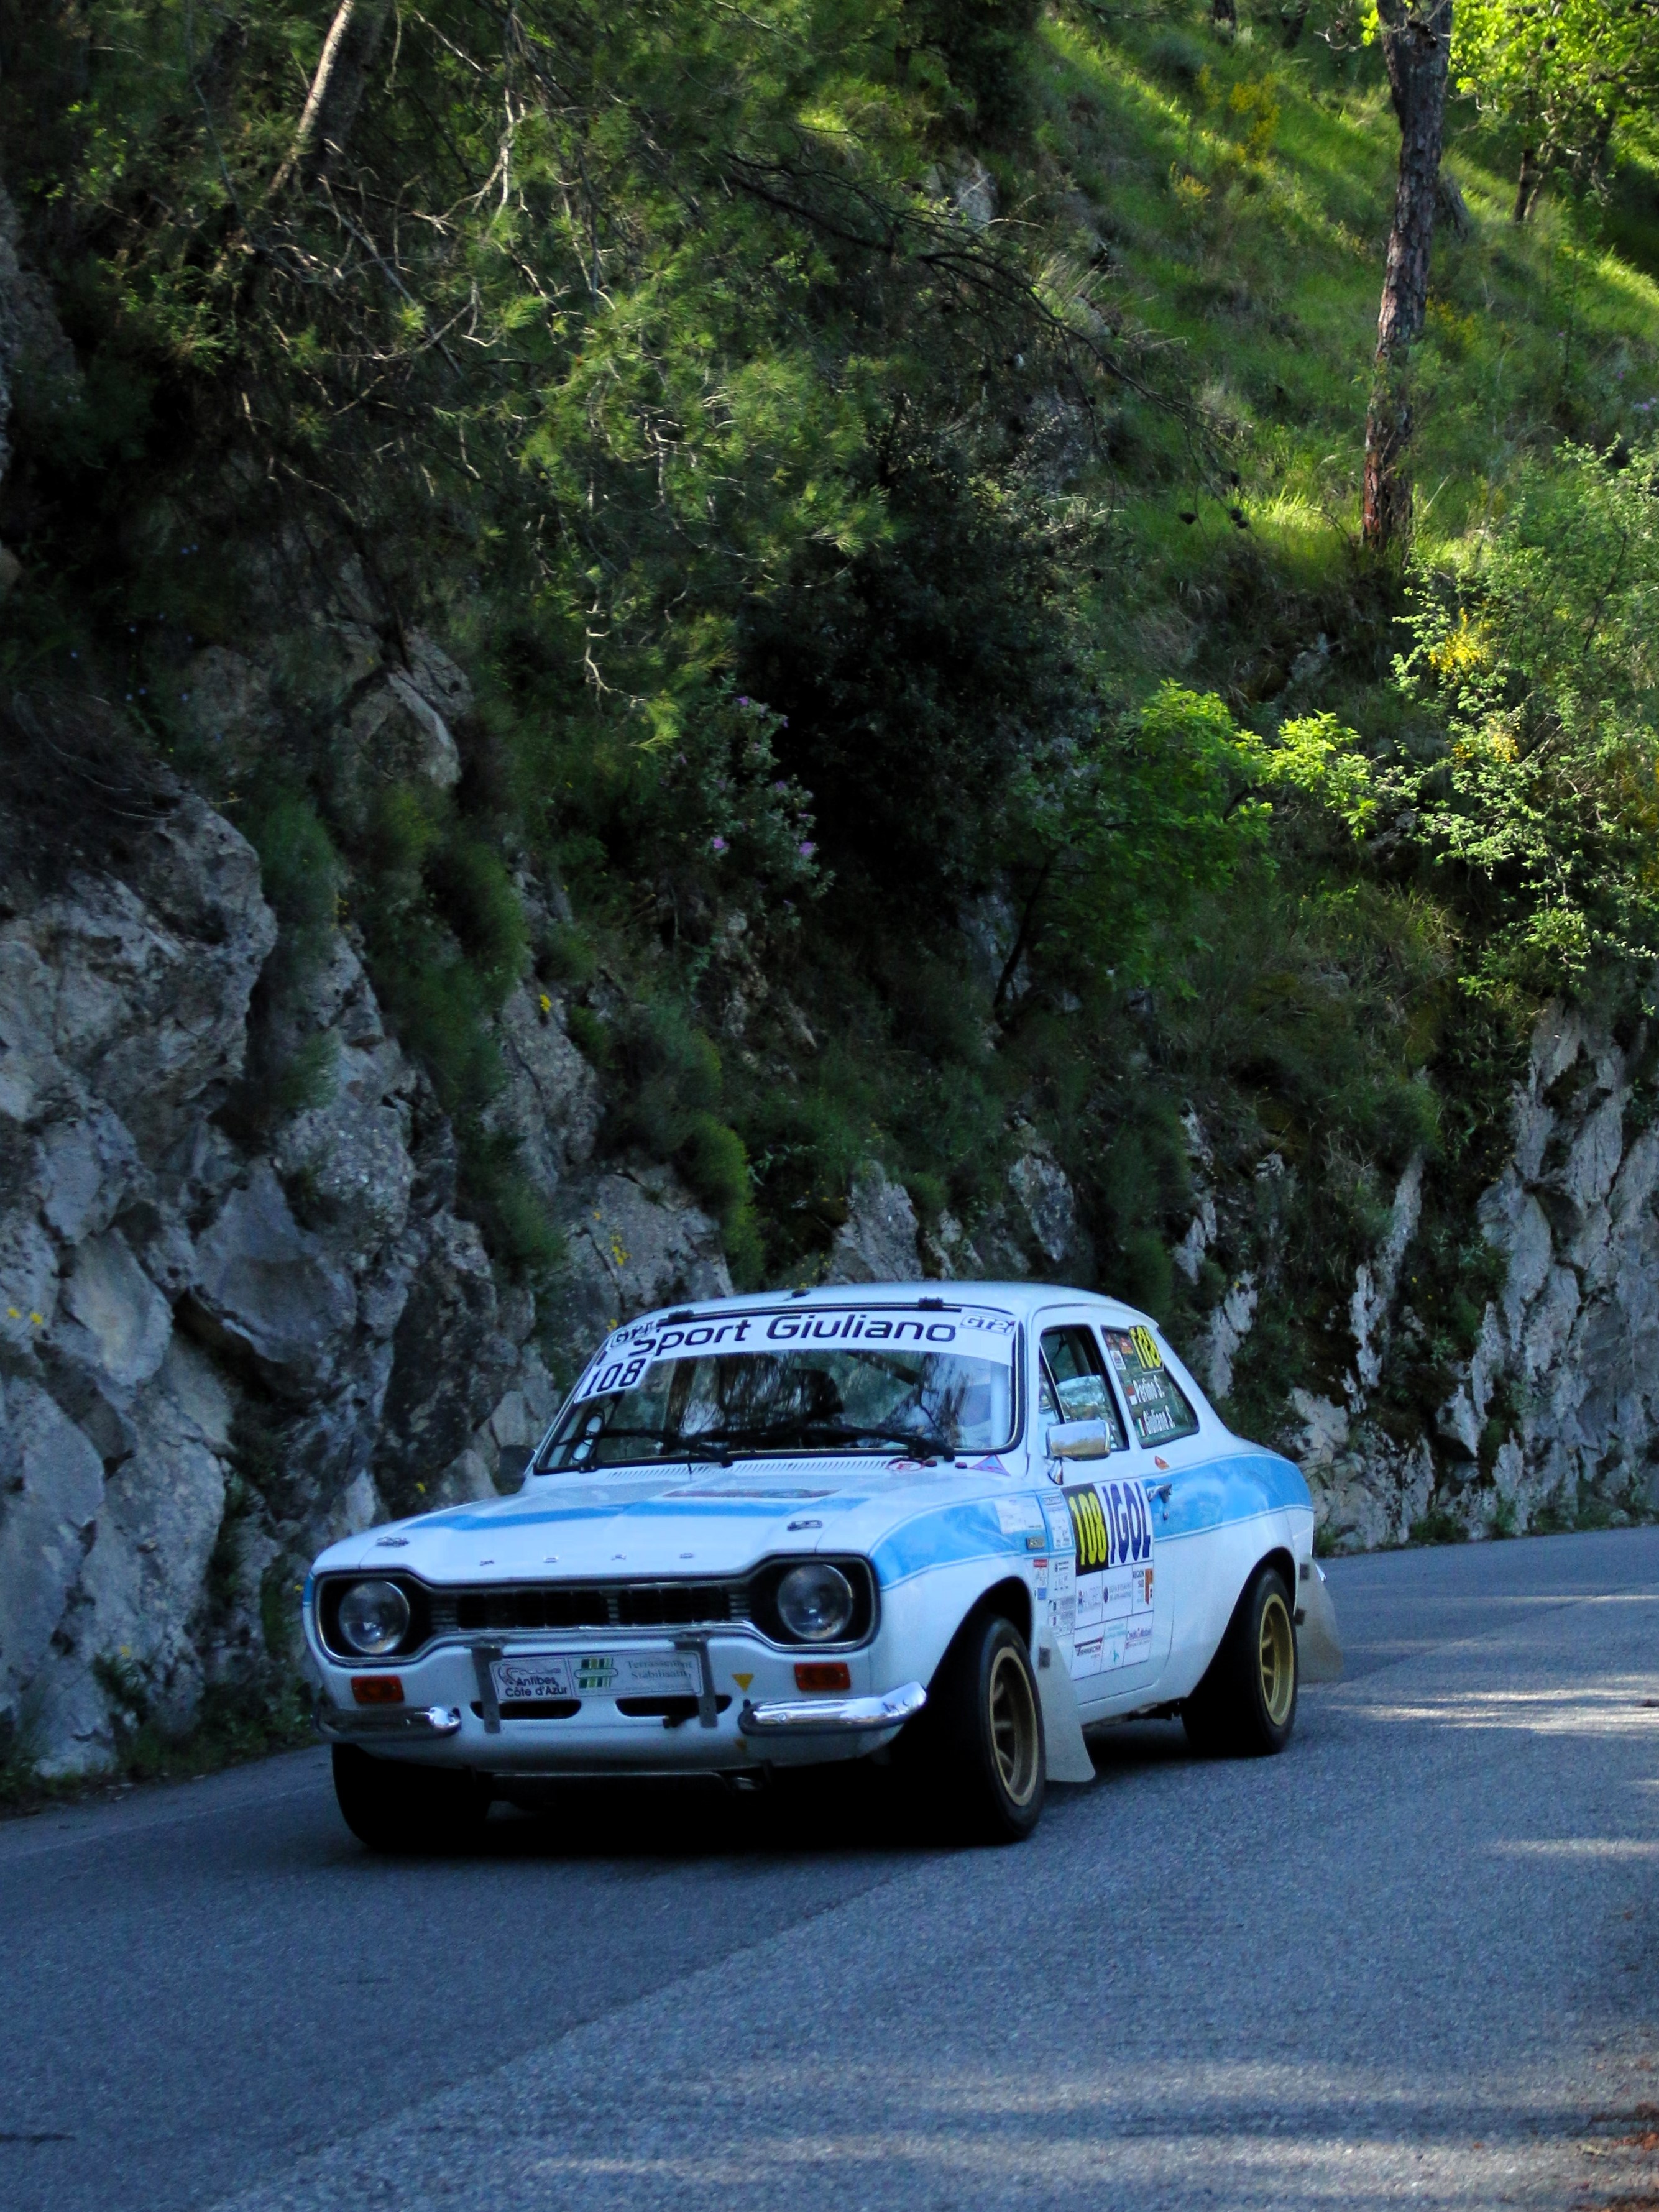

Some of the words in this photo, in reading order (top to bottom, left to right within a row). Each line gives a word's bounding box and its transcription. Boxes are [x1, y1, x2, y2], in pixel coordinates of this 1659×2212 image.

[628, 1319, 752, 1357] Sport
[766, 1314, 957, 1342] Giuliano
[1129, 1325, 1162, 1369] 108
[581, 1357, 647, 1398] 108
[1068, 1492, 1107, 1566] 108
[1101, 1481, 1151, 1564] IGOL
[516, 1675, 556, 1686] Antibes
[535, 1685, 567, 1696] d'Azur
